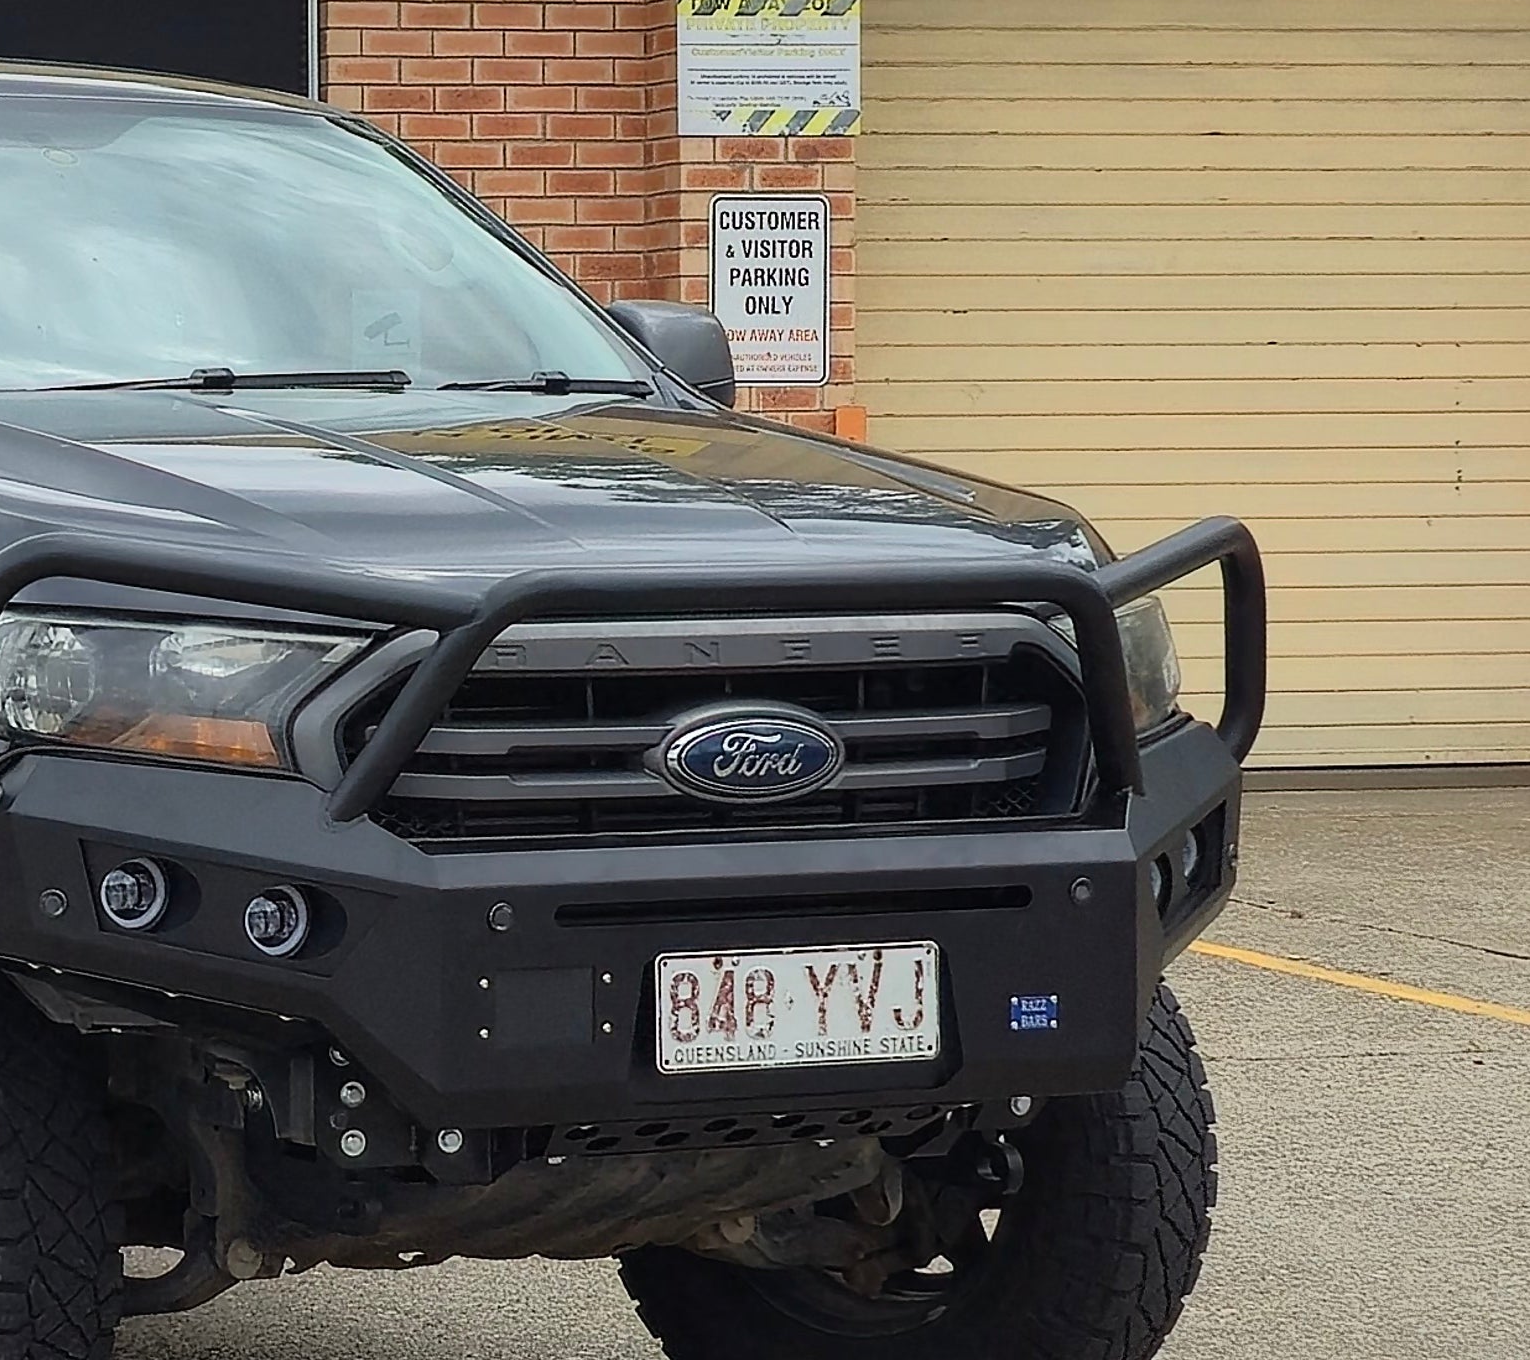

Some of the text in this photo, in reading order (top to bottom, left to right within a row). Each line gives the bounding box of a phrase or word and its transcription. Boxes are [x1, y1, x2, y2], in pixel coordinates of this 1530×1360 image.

[719, 211, 820, 230] CUSTOMER
[725, 239, 813, 258] & VISITOR
[729, 267, 810, 287] PARKING
[745, 295, 794, 315] ONLY
[726, 329, 818, 342] OW AWAY AREA
[713, 732, 805, 778] Ford
[670, 959, 925, 1043] 848 YVJ
[674, 1043, 777, 1064] QUEENSLAND
[795, 1039, 871, 1058] SUNSHINE
[880, 1035, 925, 1053] STATE
